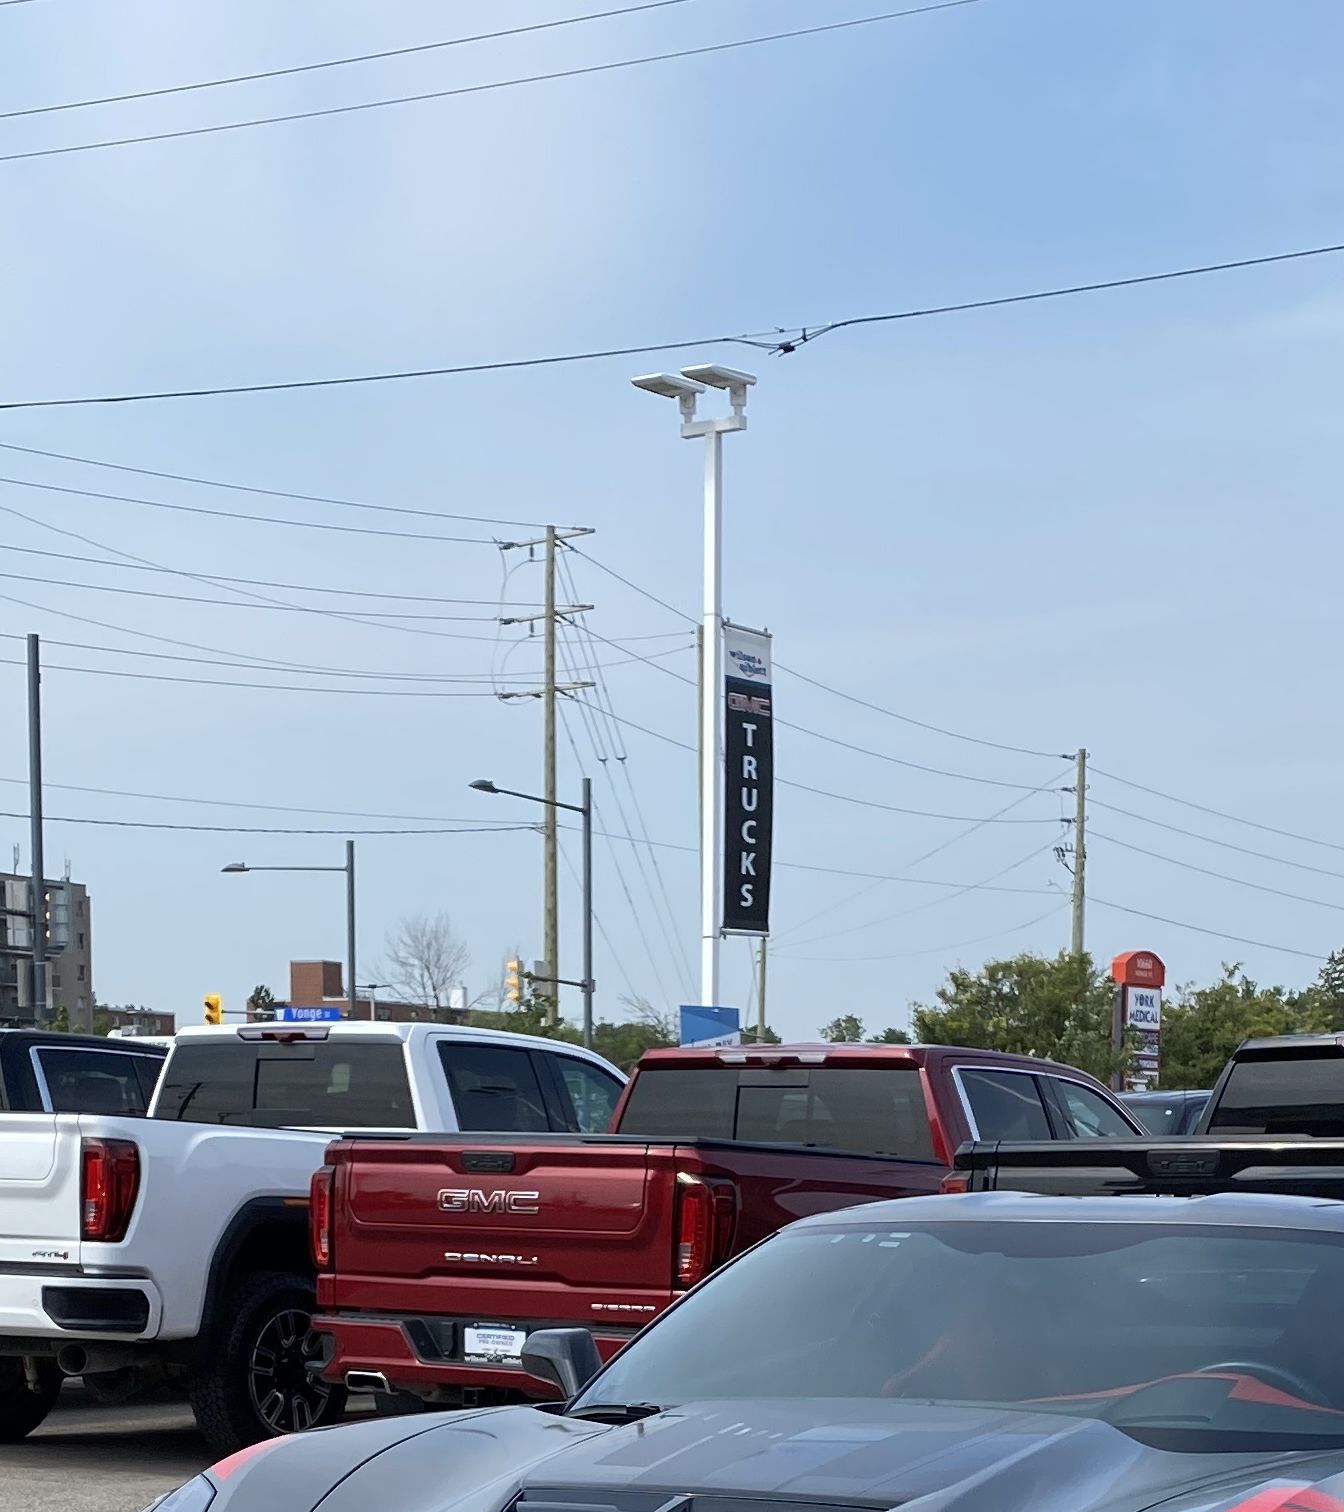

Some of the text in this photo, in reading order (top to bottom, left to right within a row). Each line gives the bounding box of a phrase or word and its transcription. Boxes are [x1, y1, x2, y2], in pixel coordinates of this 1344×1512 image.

[739, 722, 759, 908] TRUCKS
[1134, 993, 1155, 1009] YORK
[291, 1007, 323, 1022] Yonge
[1129, 1010, 1159, 1025] MEDICAL
[437, 1188, 540, 1215] GMC
[444, 1252, 538, 1265] DENALI
